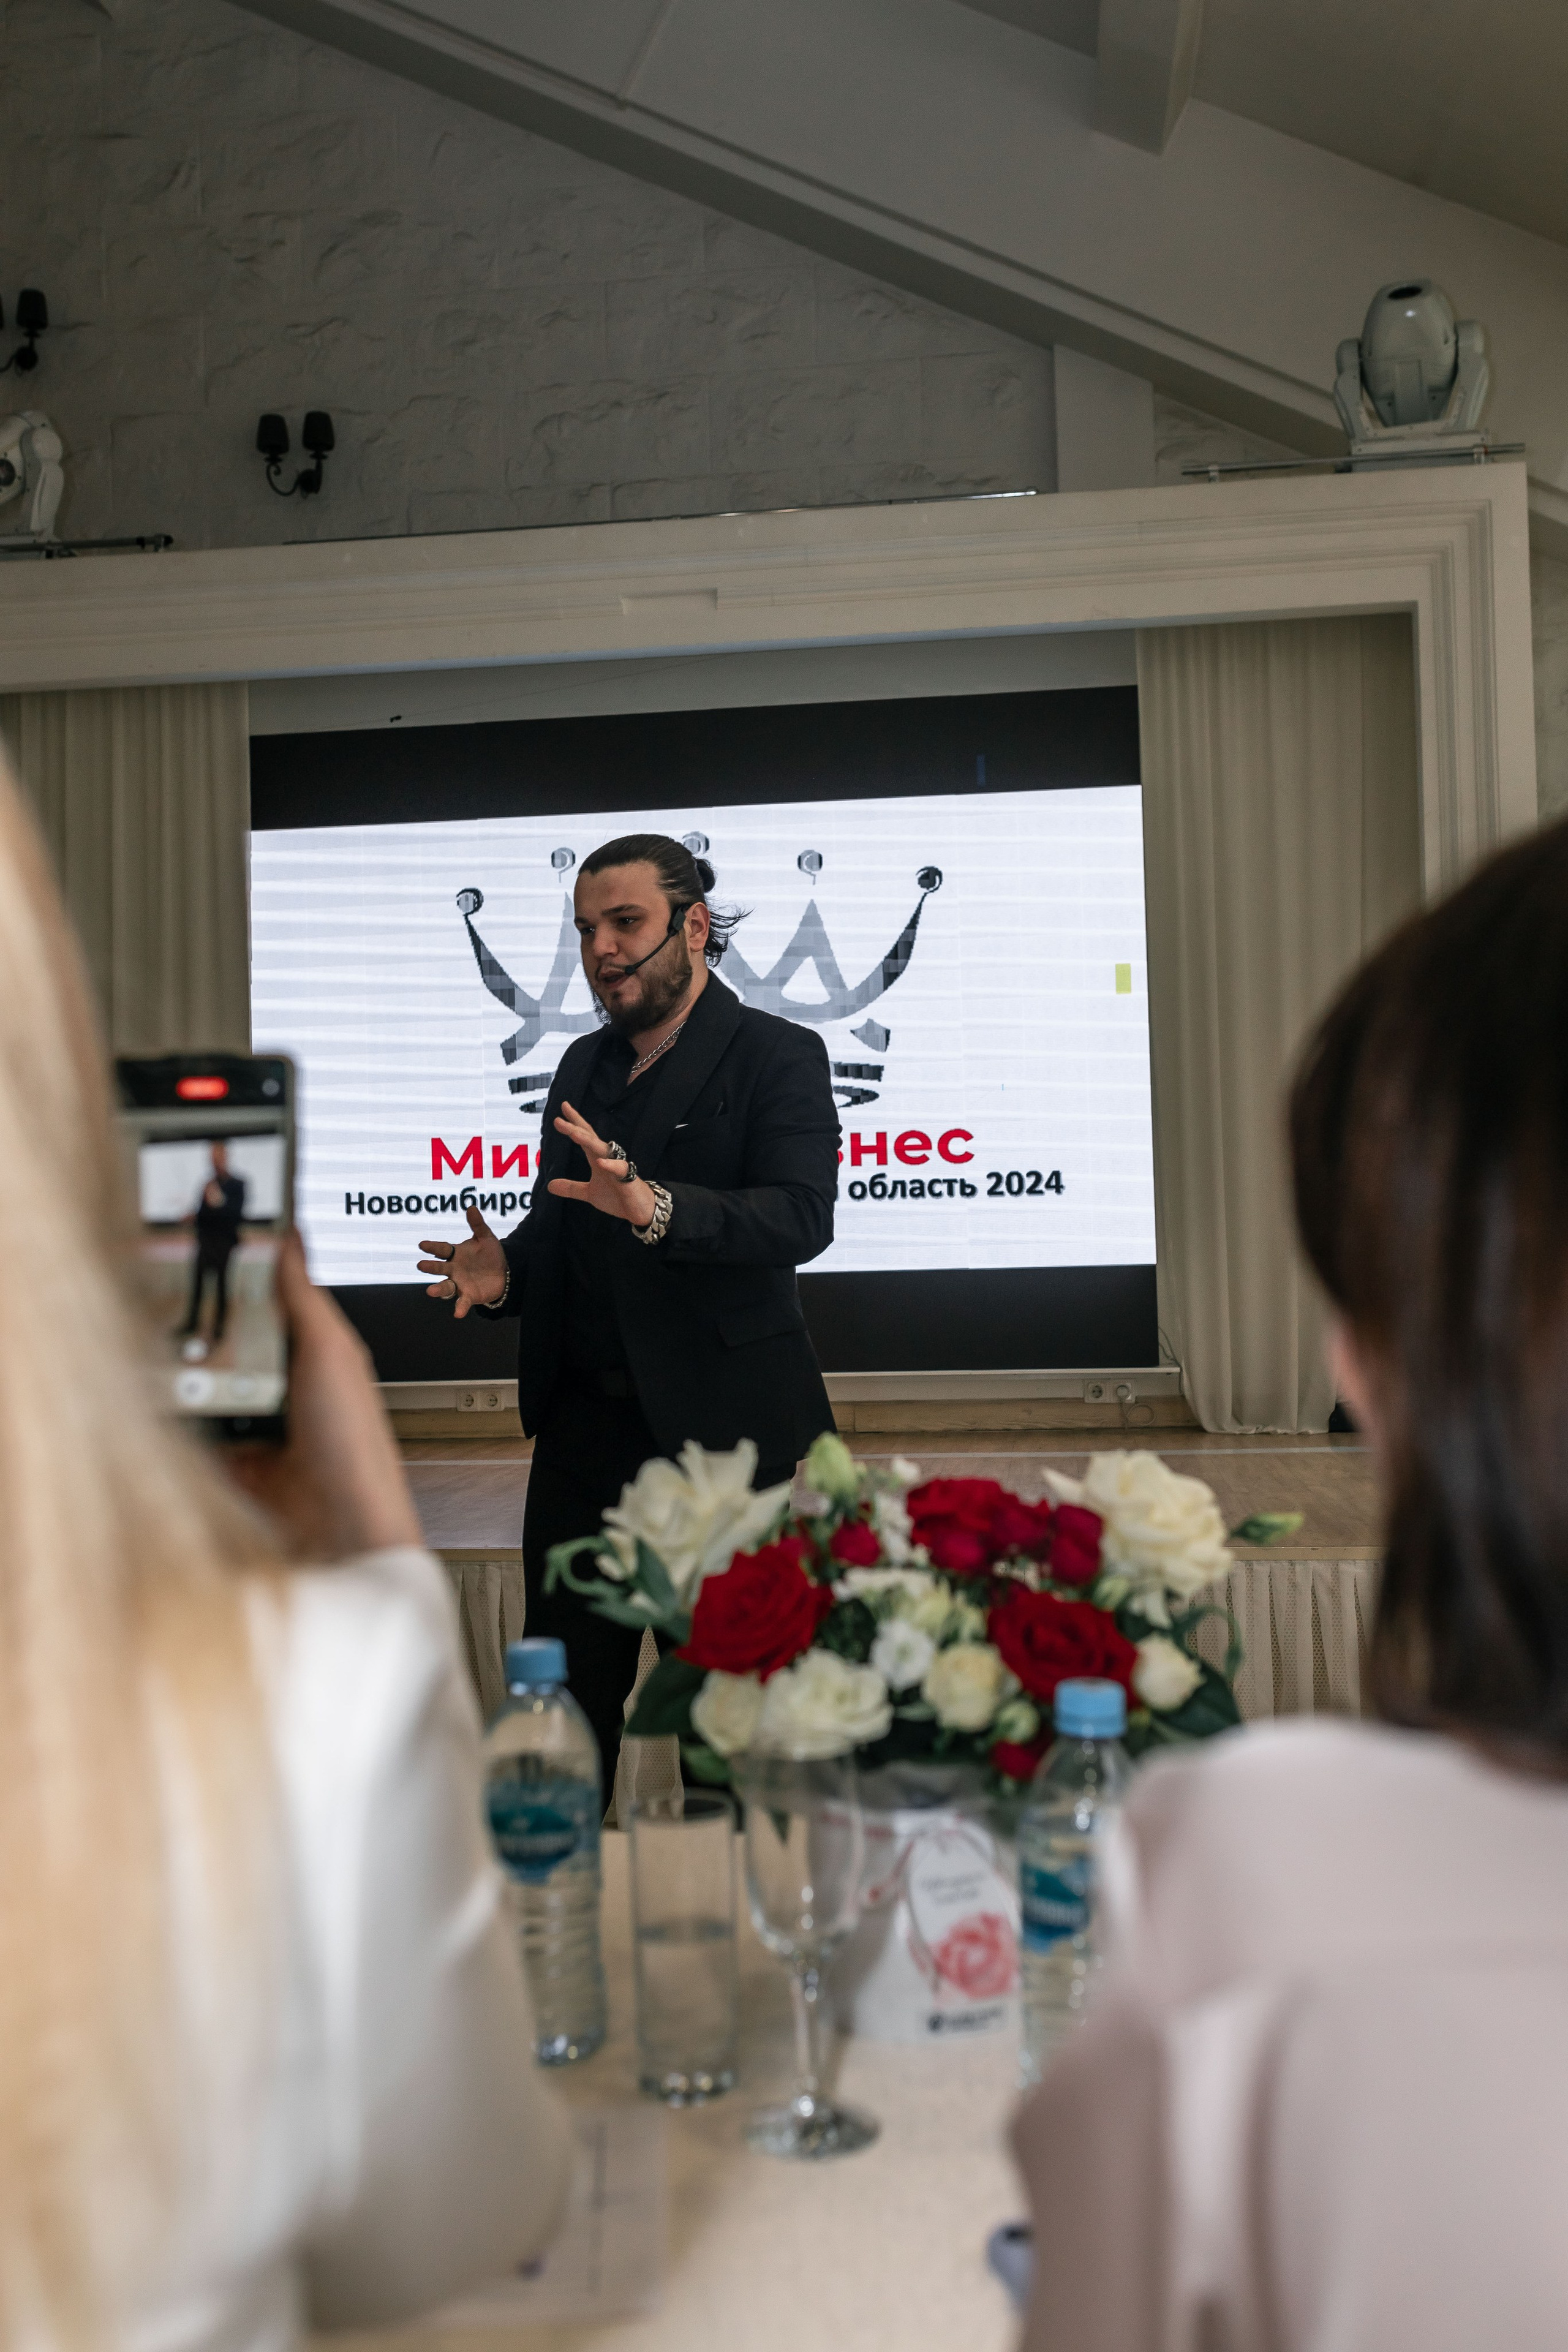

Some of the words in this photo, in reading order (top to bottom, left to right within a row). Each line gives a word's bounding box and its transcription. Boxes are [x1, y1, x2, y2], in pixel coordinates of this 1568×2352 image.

[431, 1136, 541, 1180] Ми
[837, 1128, 974, 1167] нес
[345, 1186, 532, 1217] Новосибирс
[848, 1172, 978, 1200] область
[986, 1169, 1065, 1197] 2024
